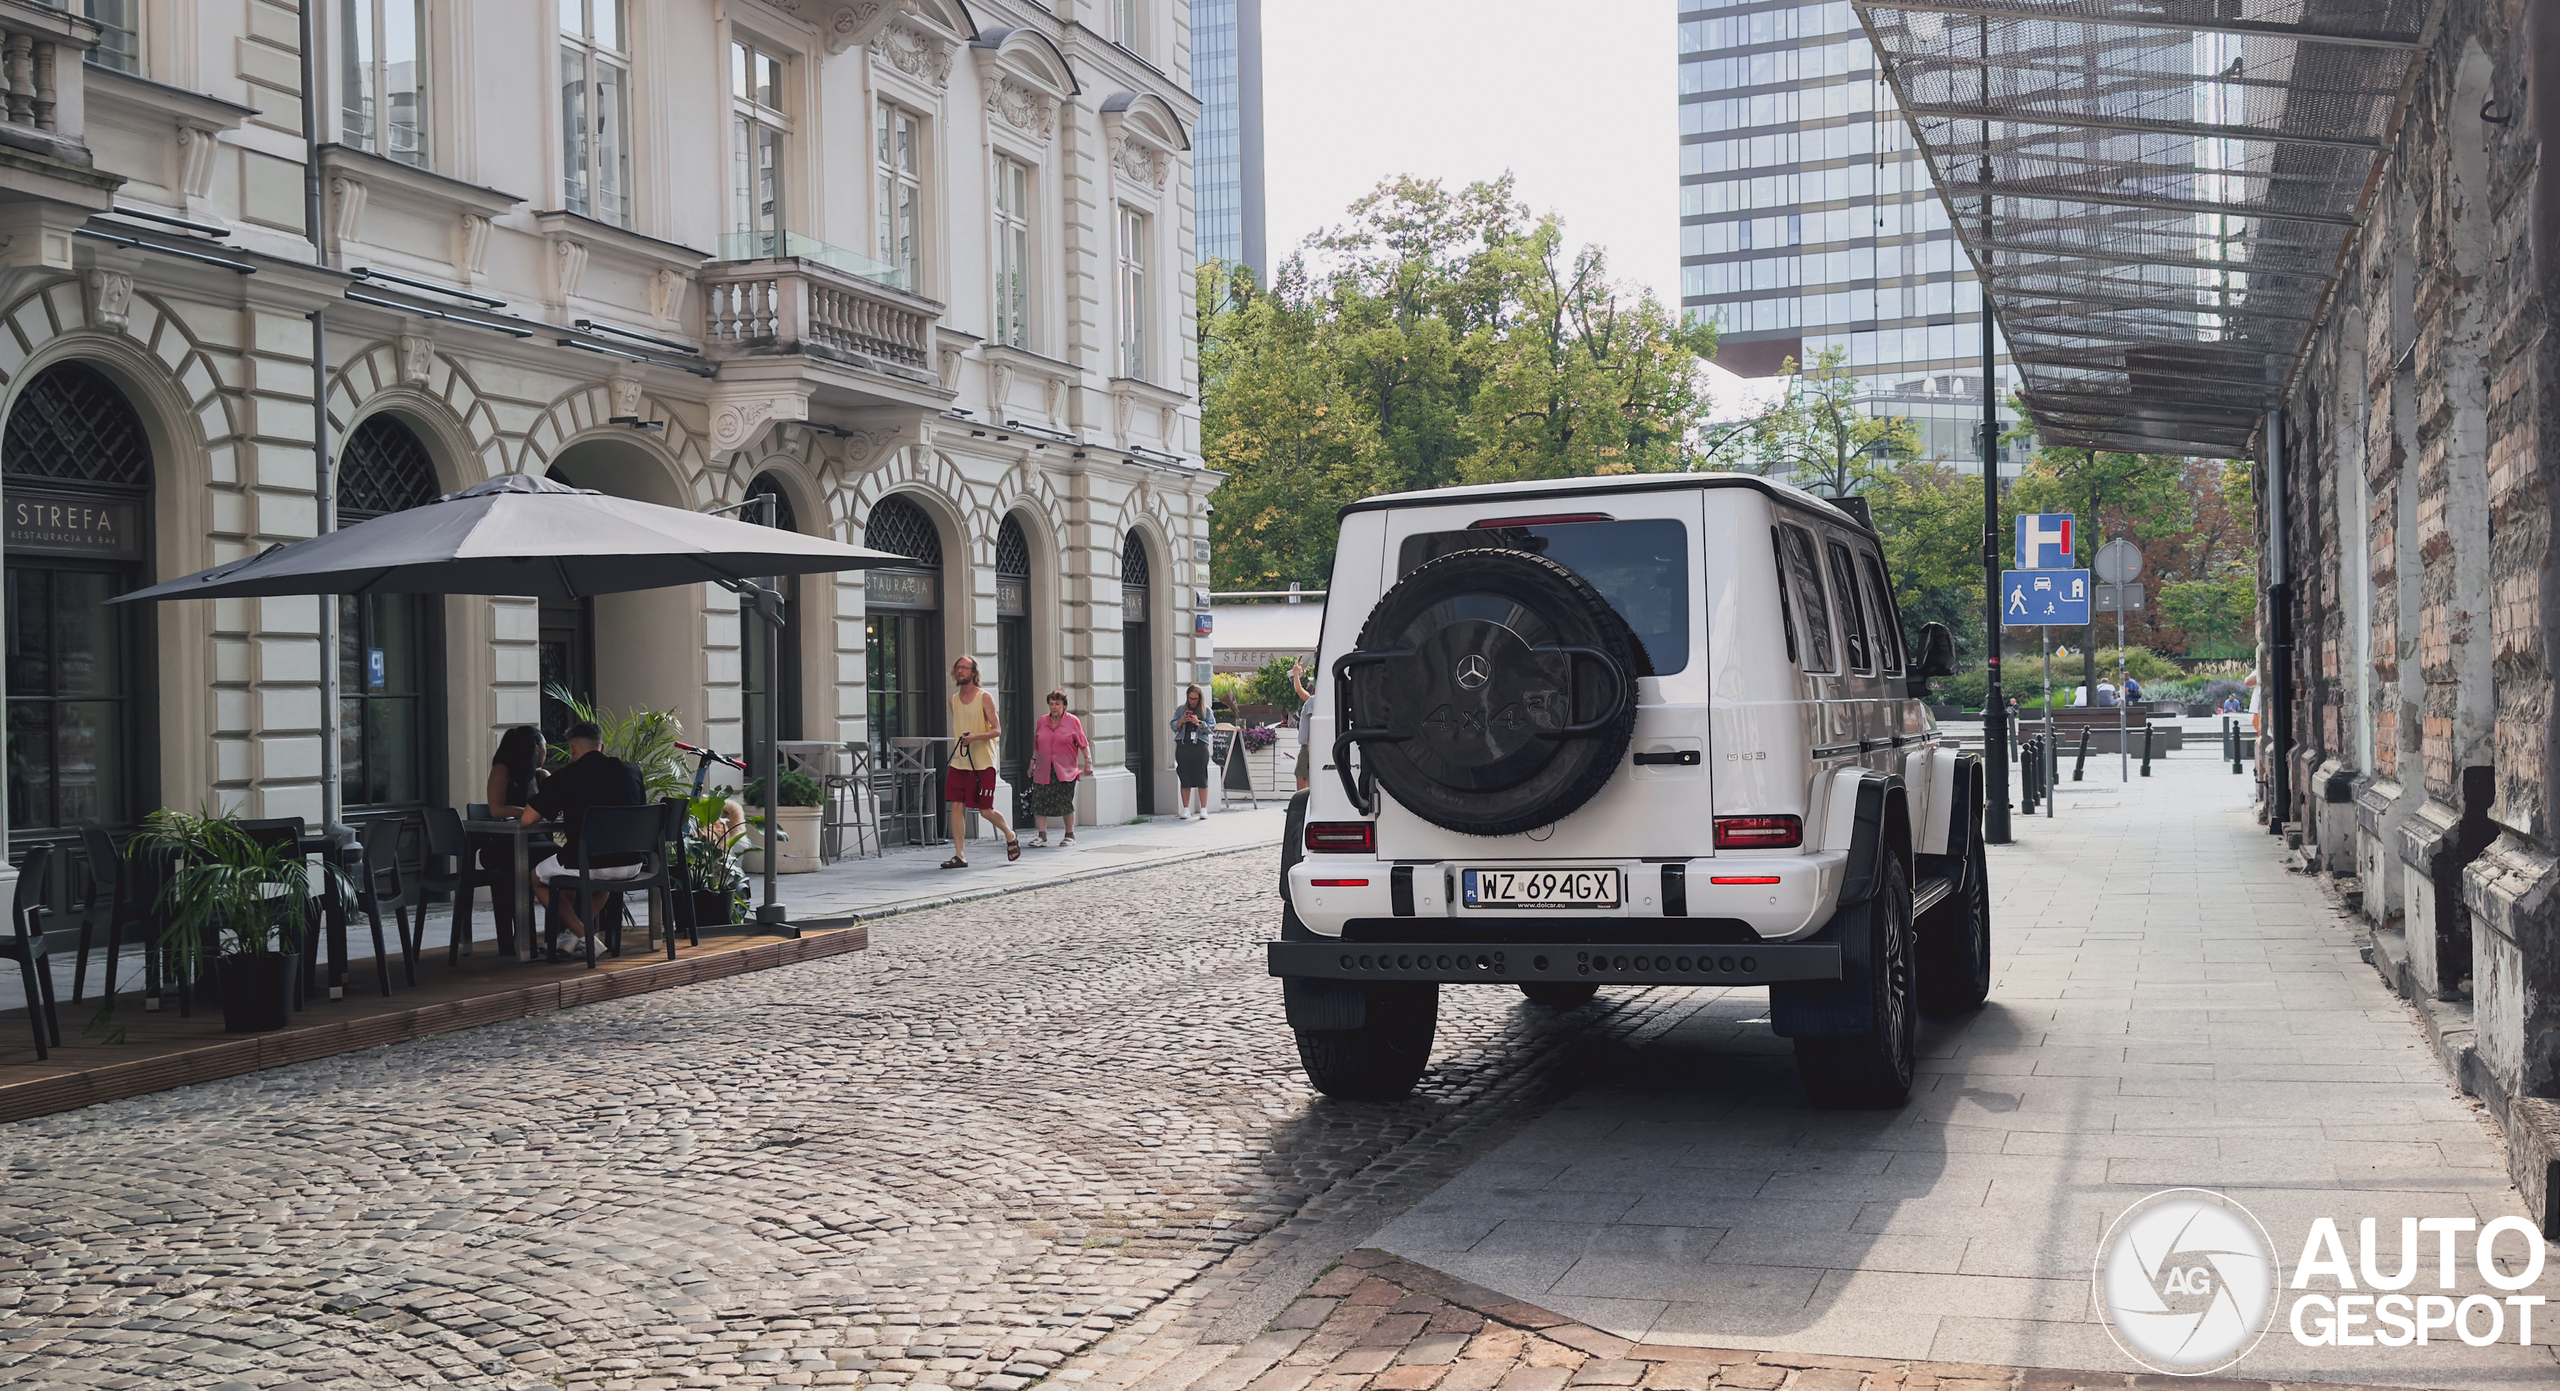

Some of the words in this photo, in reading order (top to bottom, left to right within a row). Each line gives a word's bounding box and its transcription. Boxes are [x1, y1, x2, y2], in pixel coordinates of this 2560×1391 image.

[17, 503, 112, 532] STREFA
[11, 530, 82, 543] RESTAURACJA
[1467, 889, 1477, 898] PL
[1482, 873, 1516, 900] WZ
[1526, 873, 1610, 900] 694GX
